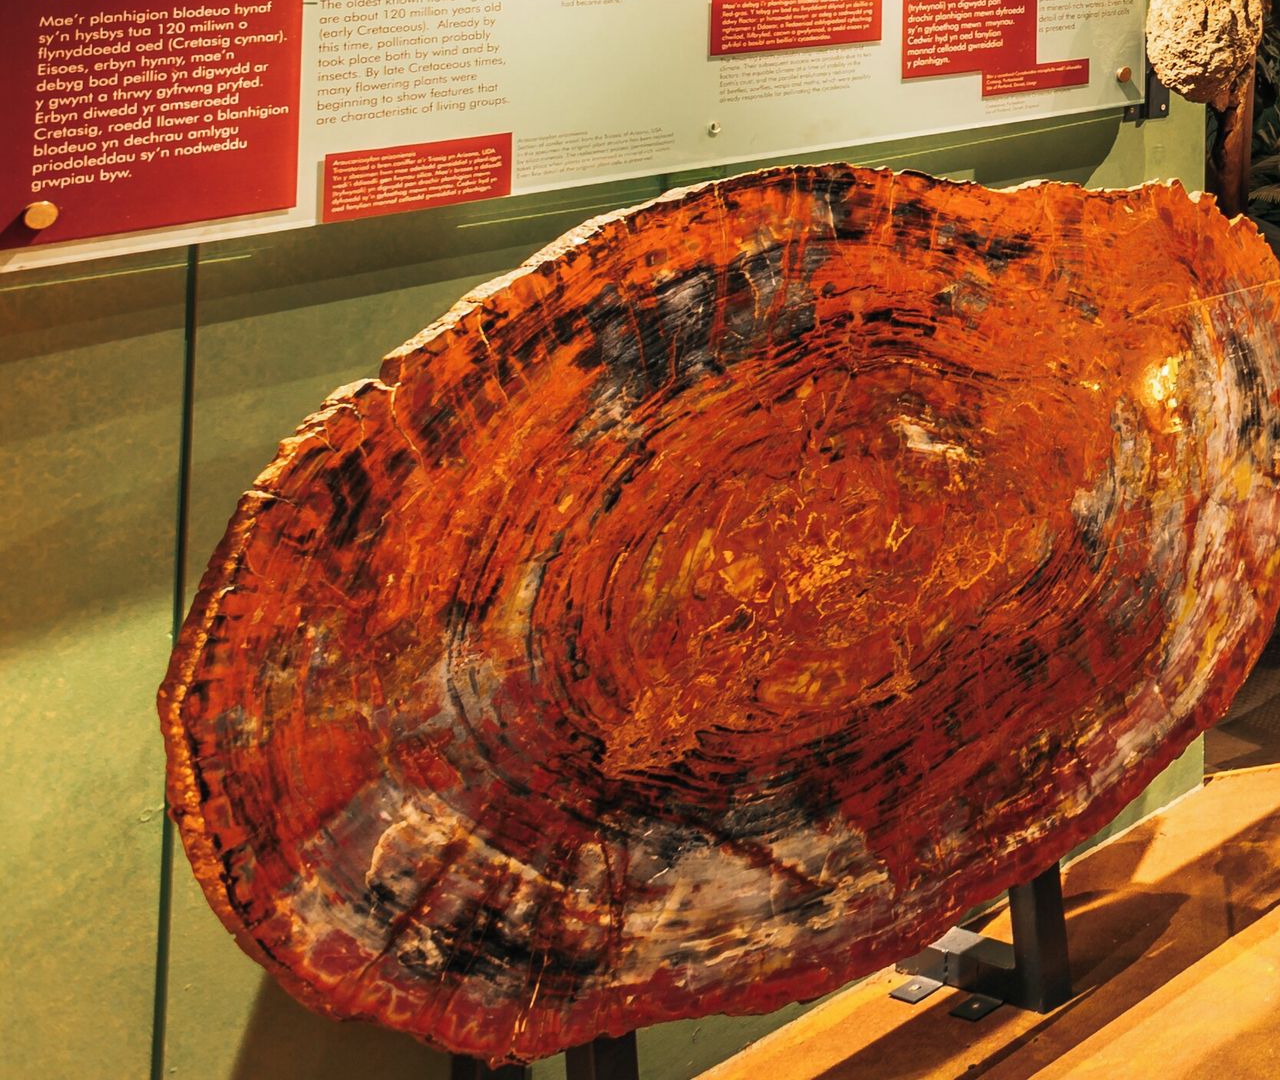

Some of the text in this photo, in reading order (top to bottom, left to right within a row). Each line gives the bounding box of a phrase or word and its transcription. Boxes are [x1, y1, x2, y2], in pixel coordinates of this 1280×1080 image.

[39, 0, 272, 28] Mae'r planhigion blodeuo hynaf
[38, 19, 248, 47] sy'n hysbys tua 120 miliwn o
[38, 30, 288, 62] flynyddoedd oed (Cretasig cynnar).
[37, 48, 234, 75] Eisoes, erbyn hynny, mae'n
